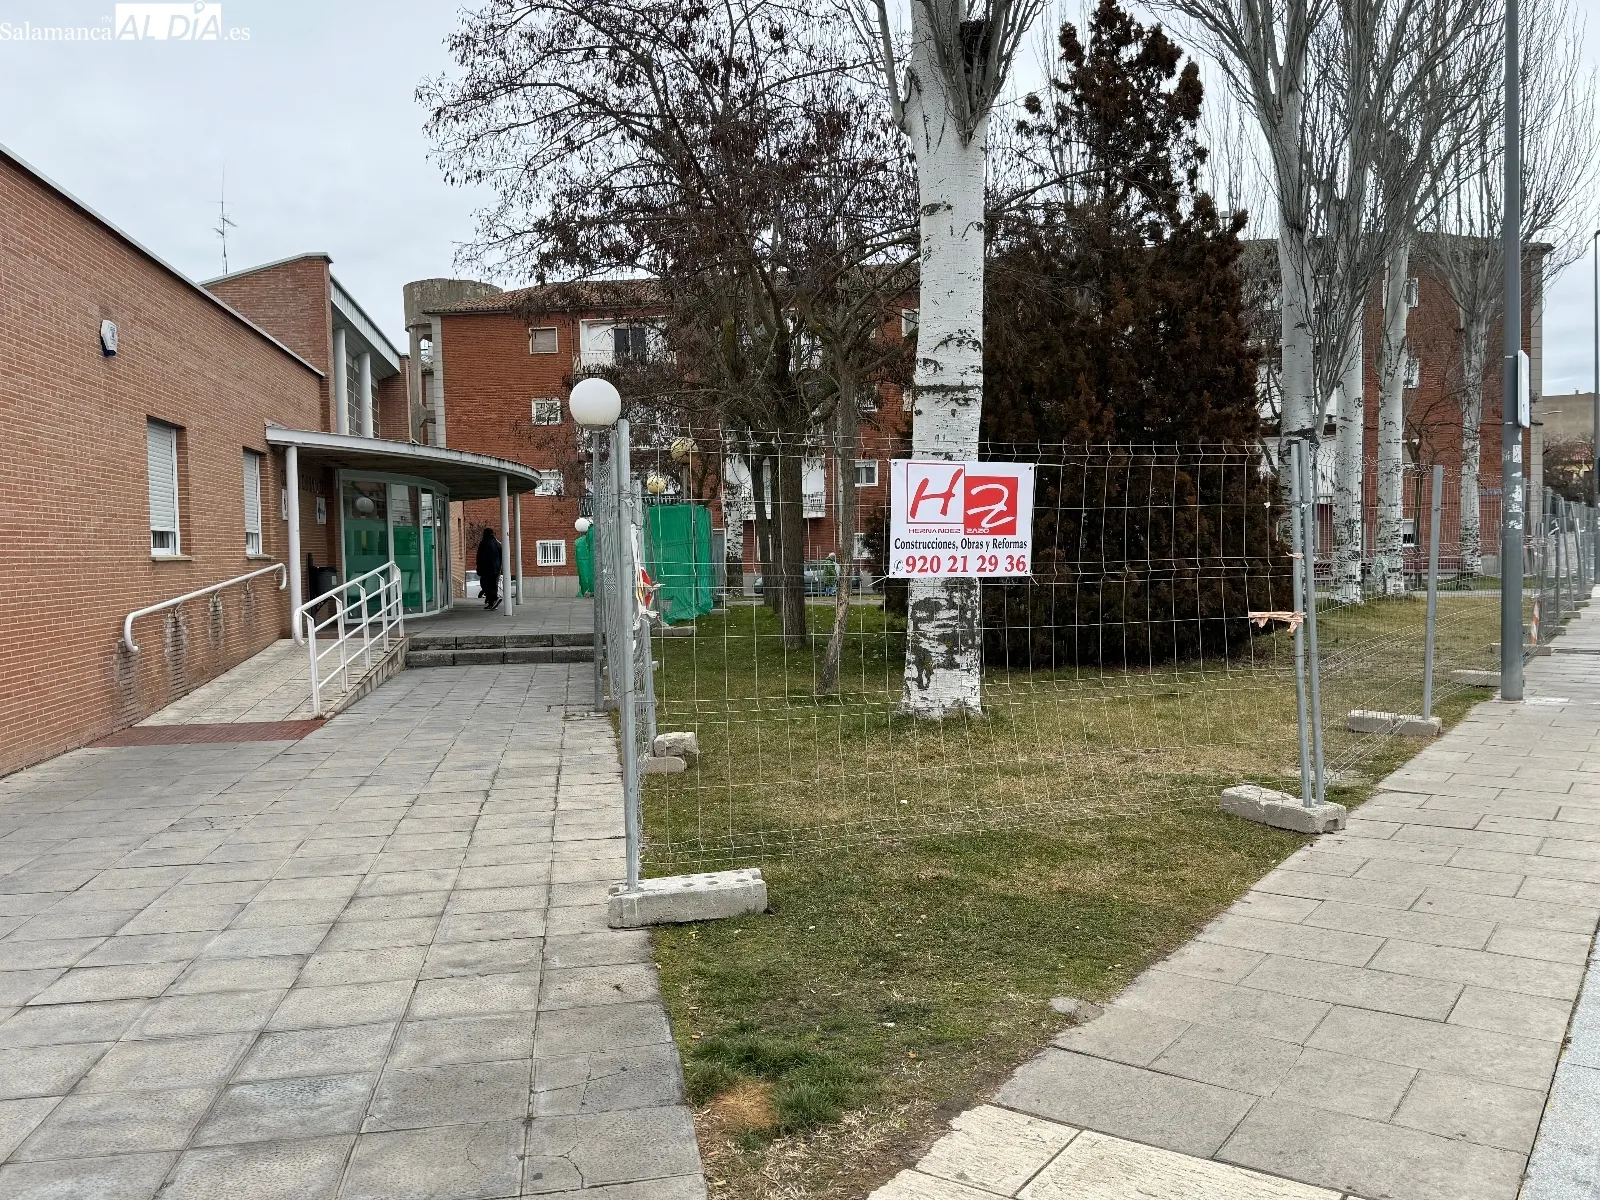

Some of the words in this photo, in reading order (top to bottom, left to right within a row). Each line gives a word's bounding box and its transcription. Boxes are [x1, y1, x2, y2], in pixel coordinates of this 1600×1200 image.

[894, 537, 958, 551] Construcciones,
[961, 537, 983, 550] Obras
[985, 541, 990, 552] y
[992, 538, 1028, 550] Reformas
[905, 555, 942, 574] 920
[947, 555, 968, 573] 21
[976, 554, 999, 573] 29
[1004, 554, 1027, 573] 36
